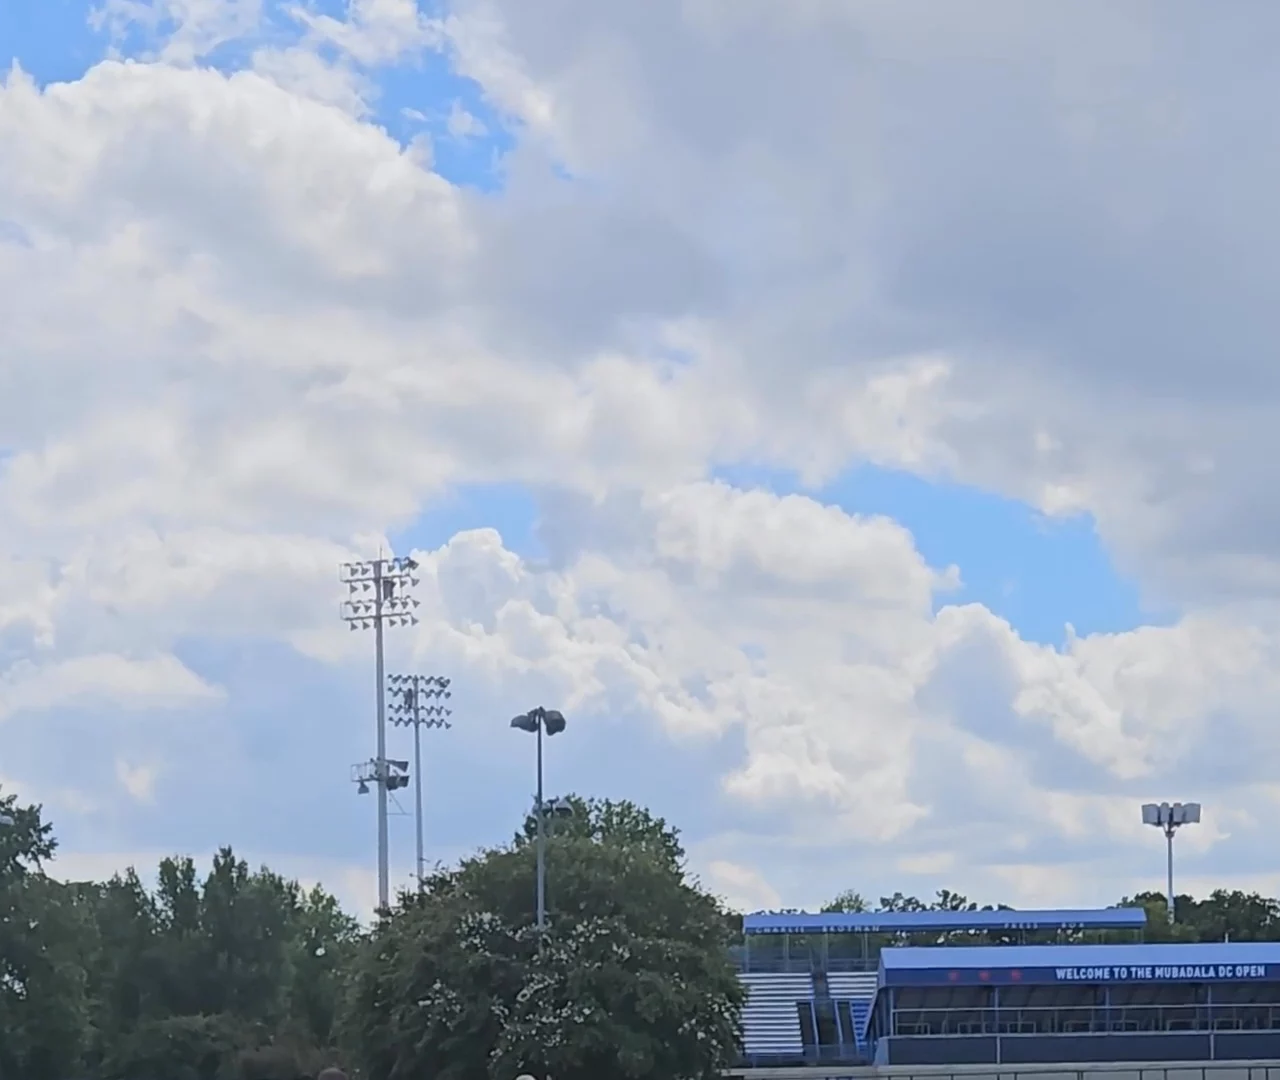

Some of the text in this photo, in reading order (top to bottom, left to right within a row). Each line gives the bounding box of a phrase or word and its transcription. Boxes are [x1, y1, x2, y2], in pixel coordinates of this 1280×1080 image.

[1056, 965, 1266, 980] WELCOME TO THE MUBADALA DC OPEN
